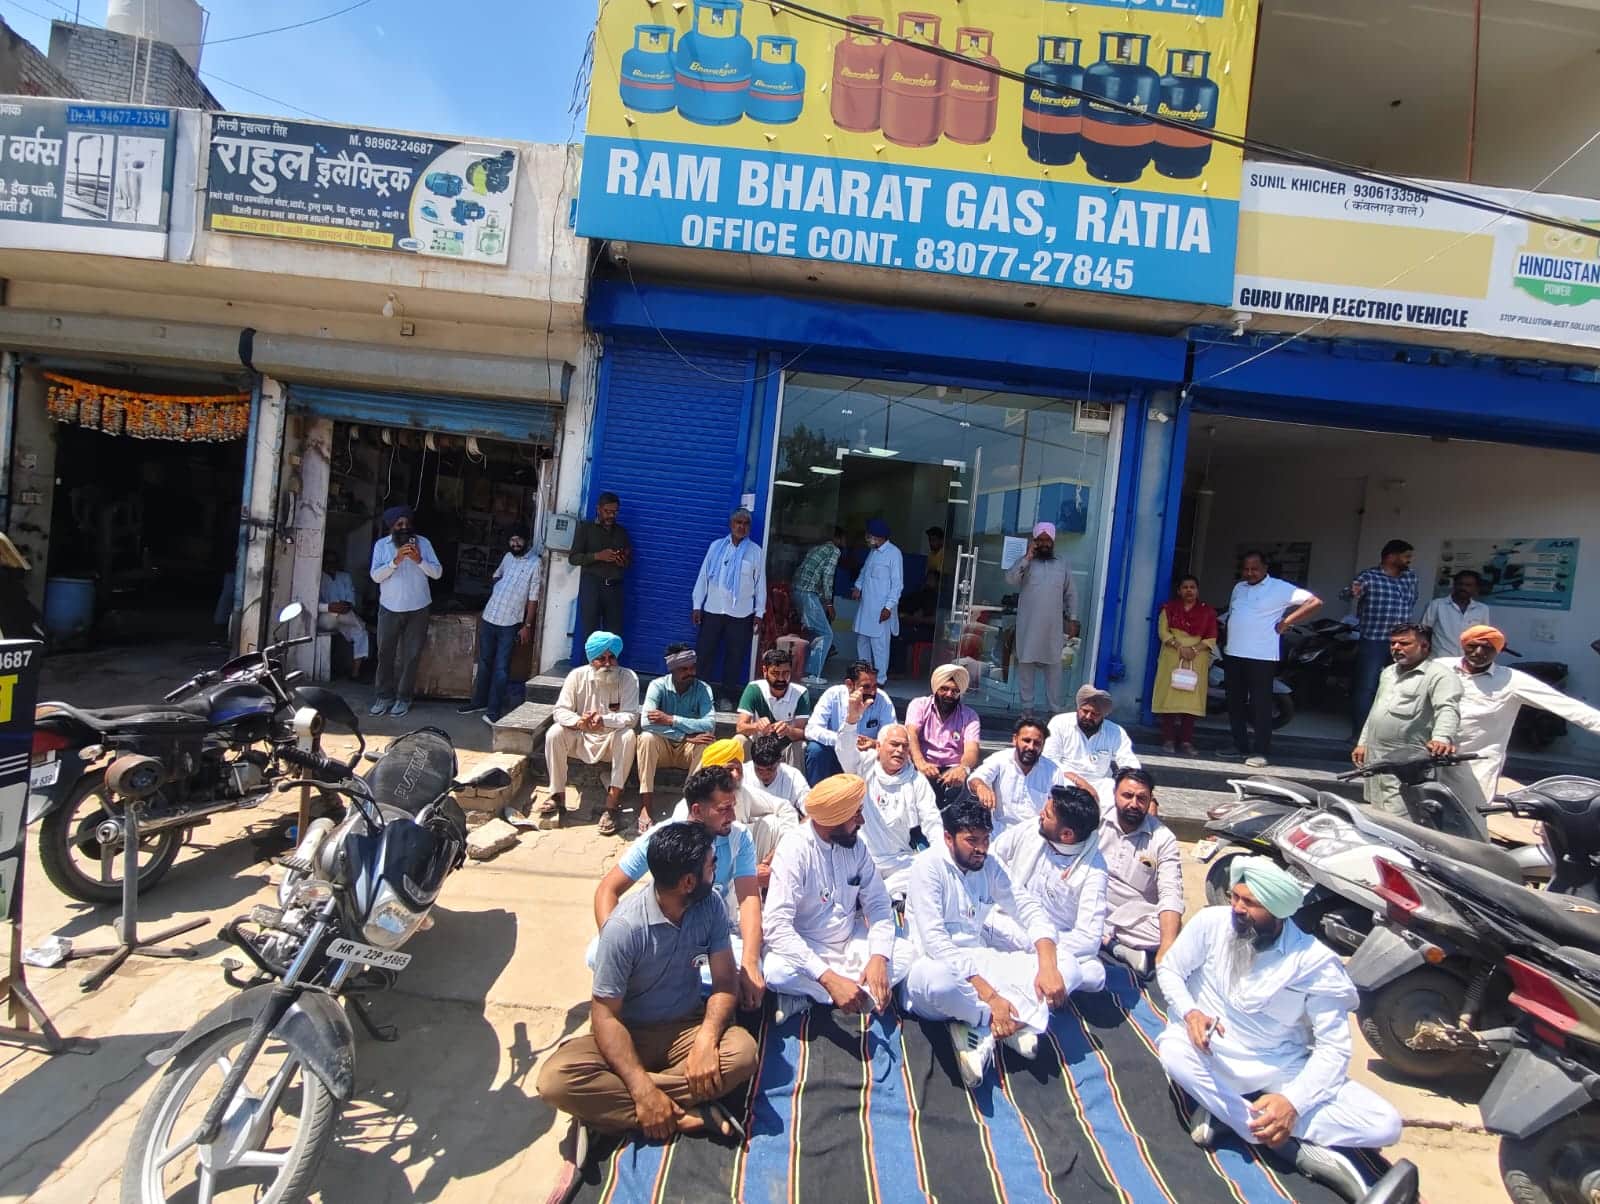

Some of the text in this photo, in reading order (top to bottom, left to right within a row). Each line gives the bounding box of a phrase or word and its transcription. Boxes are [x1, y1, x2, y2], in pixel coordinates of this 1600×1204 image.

[349, 134, 434, 155] M. 98962-24687
[212, 136, 314, 194] राहुल
[1250, 174, 1287, 190] SUNIL
[1291, 178, 1346, 196] KHICHER
[606, 148, 1212, 254] RAM BHARAT GAS, RATIA
[681, 214, 1135, 290] OFFICE CONT. 83077-27845
[1518, 255, 1600, 284] HINDUSTAN
[1543, 283, 1572, 297] POWER
[1240, 288, 1469, 328] GURU KRIPA ELECTRIC VEHICLE
[0, 650, 32, 670] 687
[336, 943, 354, 955] HR
